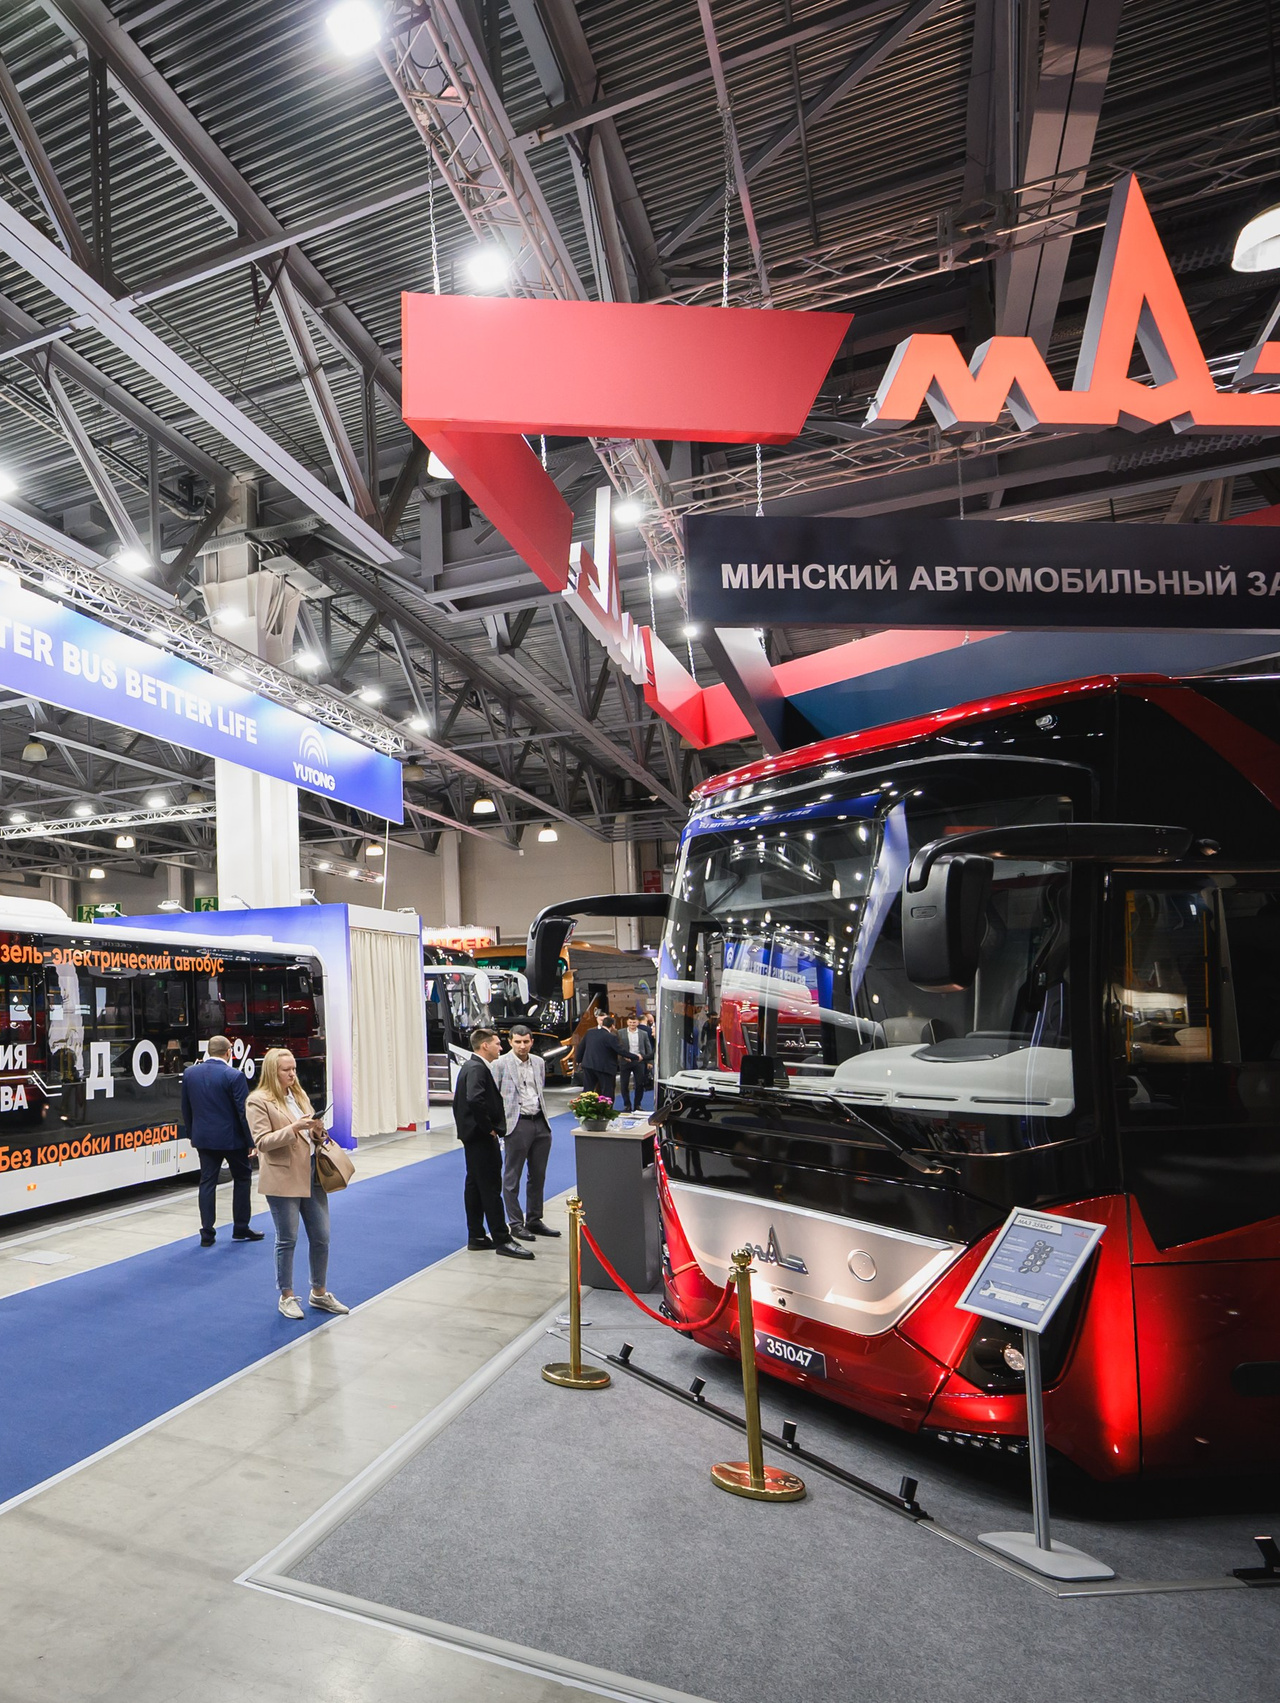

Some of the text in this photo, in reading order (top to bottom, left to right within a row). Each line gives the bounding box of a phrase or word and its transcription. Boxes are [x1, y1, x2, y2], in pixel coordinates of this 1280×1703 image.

[721, 558, 898, 590] МИНСКИЙ
[909, 565, 1237, 596] АВТОМОБИЛЬНЫЙ
[62, 640, 118, 690] BUS
[125, 667, 213, 728] BETTER
[217, 706, 258, 744] LIFE
[293, 761, 336, 791] YUTONG
[174, 954, 224, 976] автобус
[37, 1133, 110, 1166] коробки
[116, 1124, 178, 1152] передач
[766, 1338, 812, 1367] 351047
